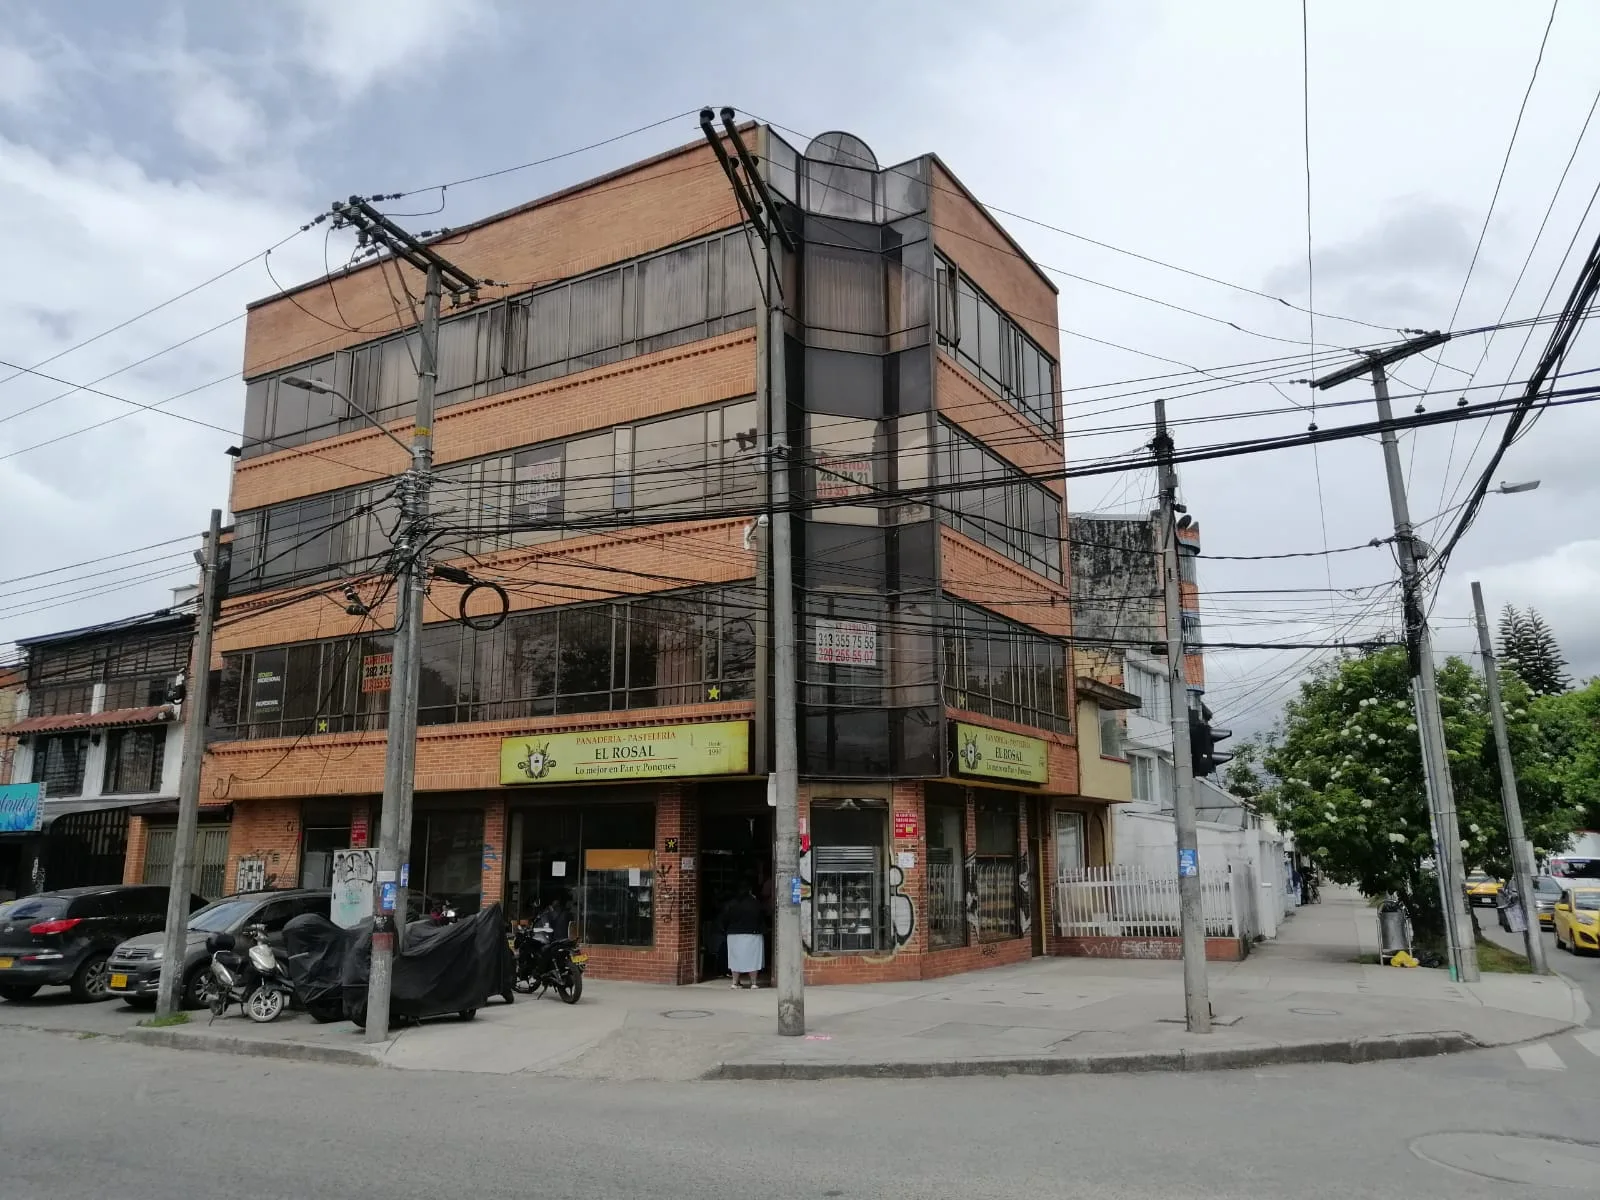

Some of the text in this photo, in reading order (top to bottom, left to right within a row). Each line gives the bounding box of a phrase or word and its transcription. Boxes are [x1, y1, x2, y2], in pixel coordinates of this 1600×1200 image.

[818, 632, 833, 647] 313
[852, 635, 862, 649] 75
[595, 745, 655, 760] EL ROSAL
[575, 766, 584, 775] Lo
[586, 765, 607, 776] mejor
[620, 764, 634, 773] Pan
